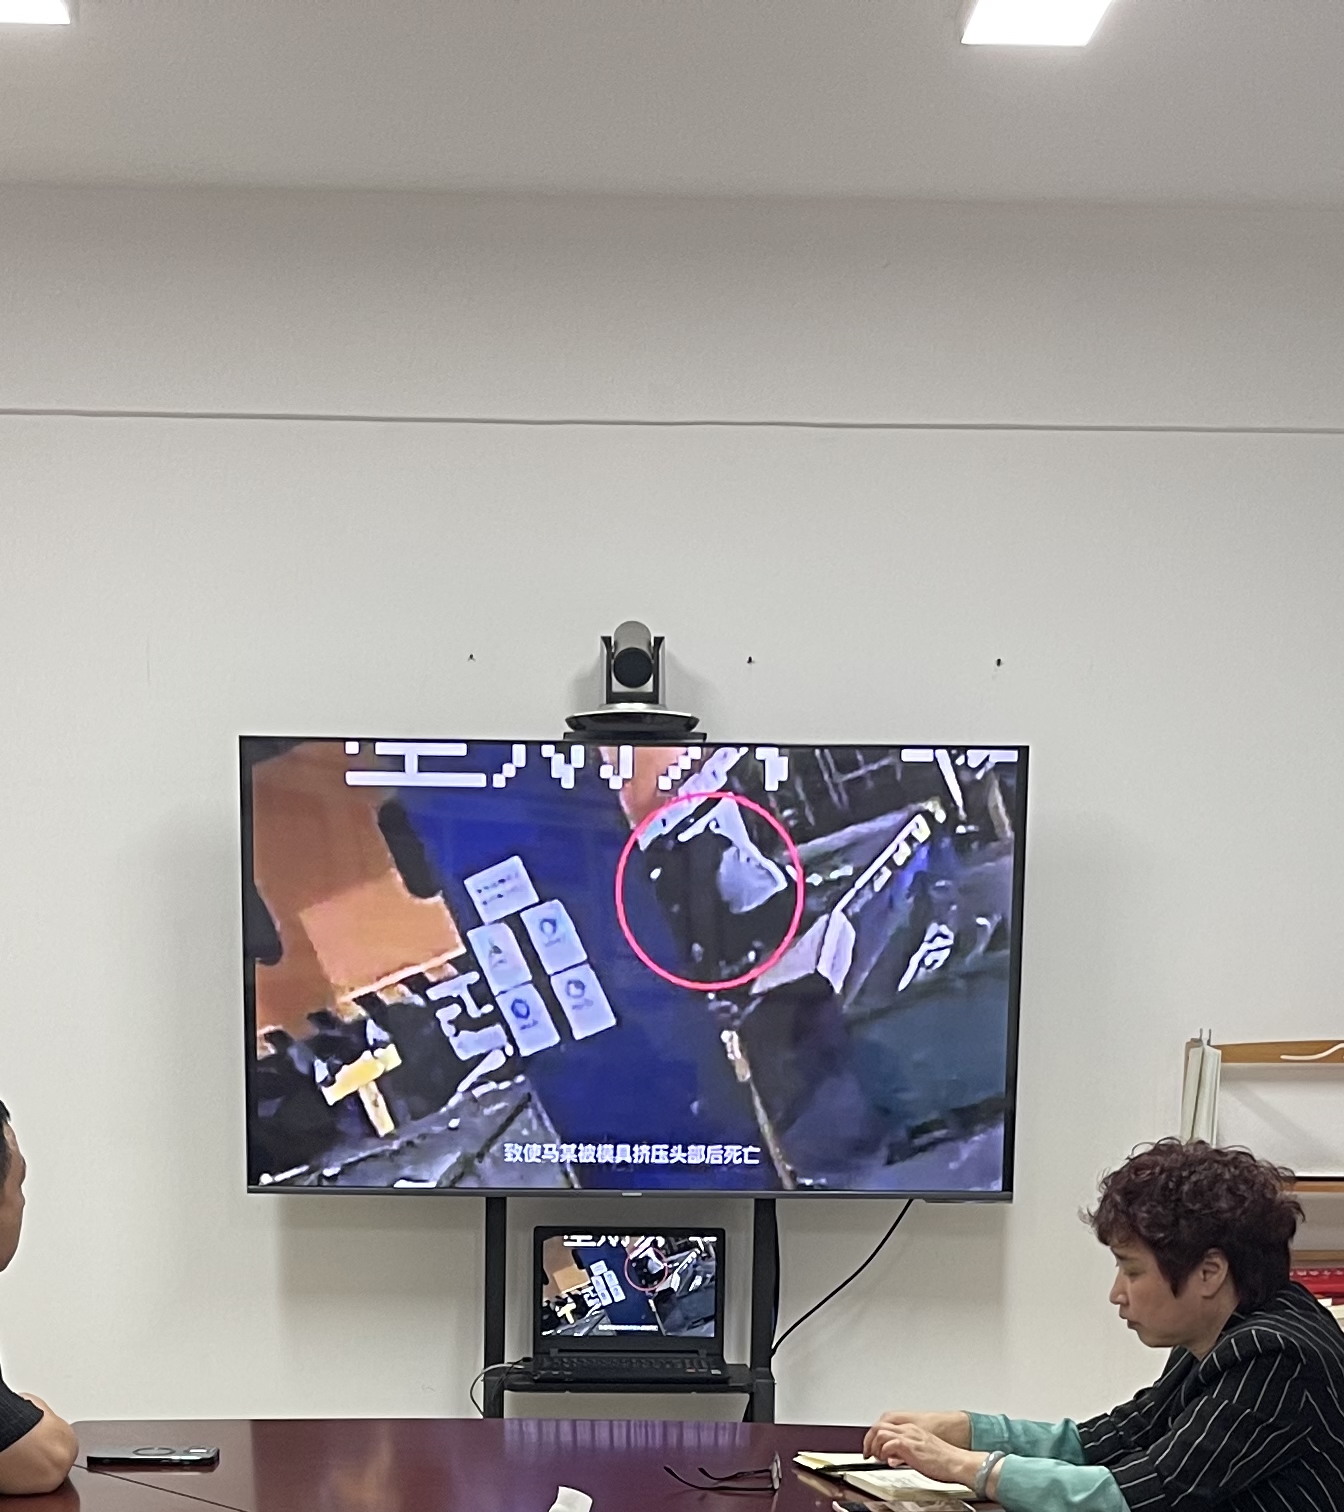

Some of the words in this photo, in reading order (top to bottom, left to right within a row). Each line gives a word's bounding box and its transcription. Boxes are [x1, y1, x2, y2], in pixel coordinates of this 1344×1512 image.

[504, 1143, 761, 1165] 致使马某被模具挤压头部后死亡
